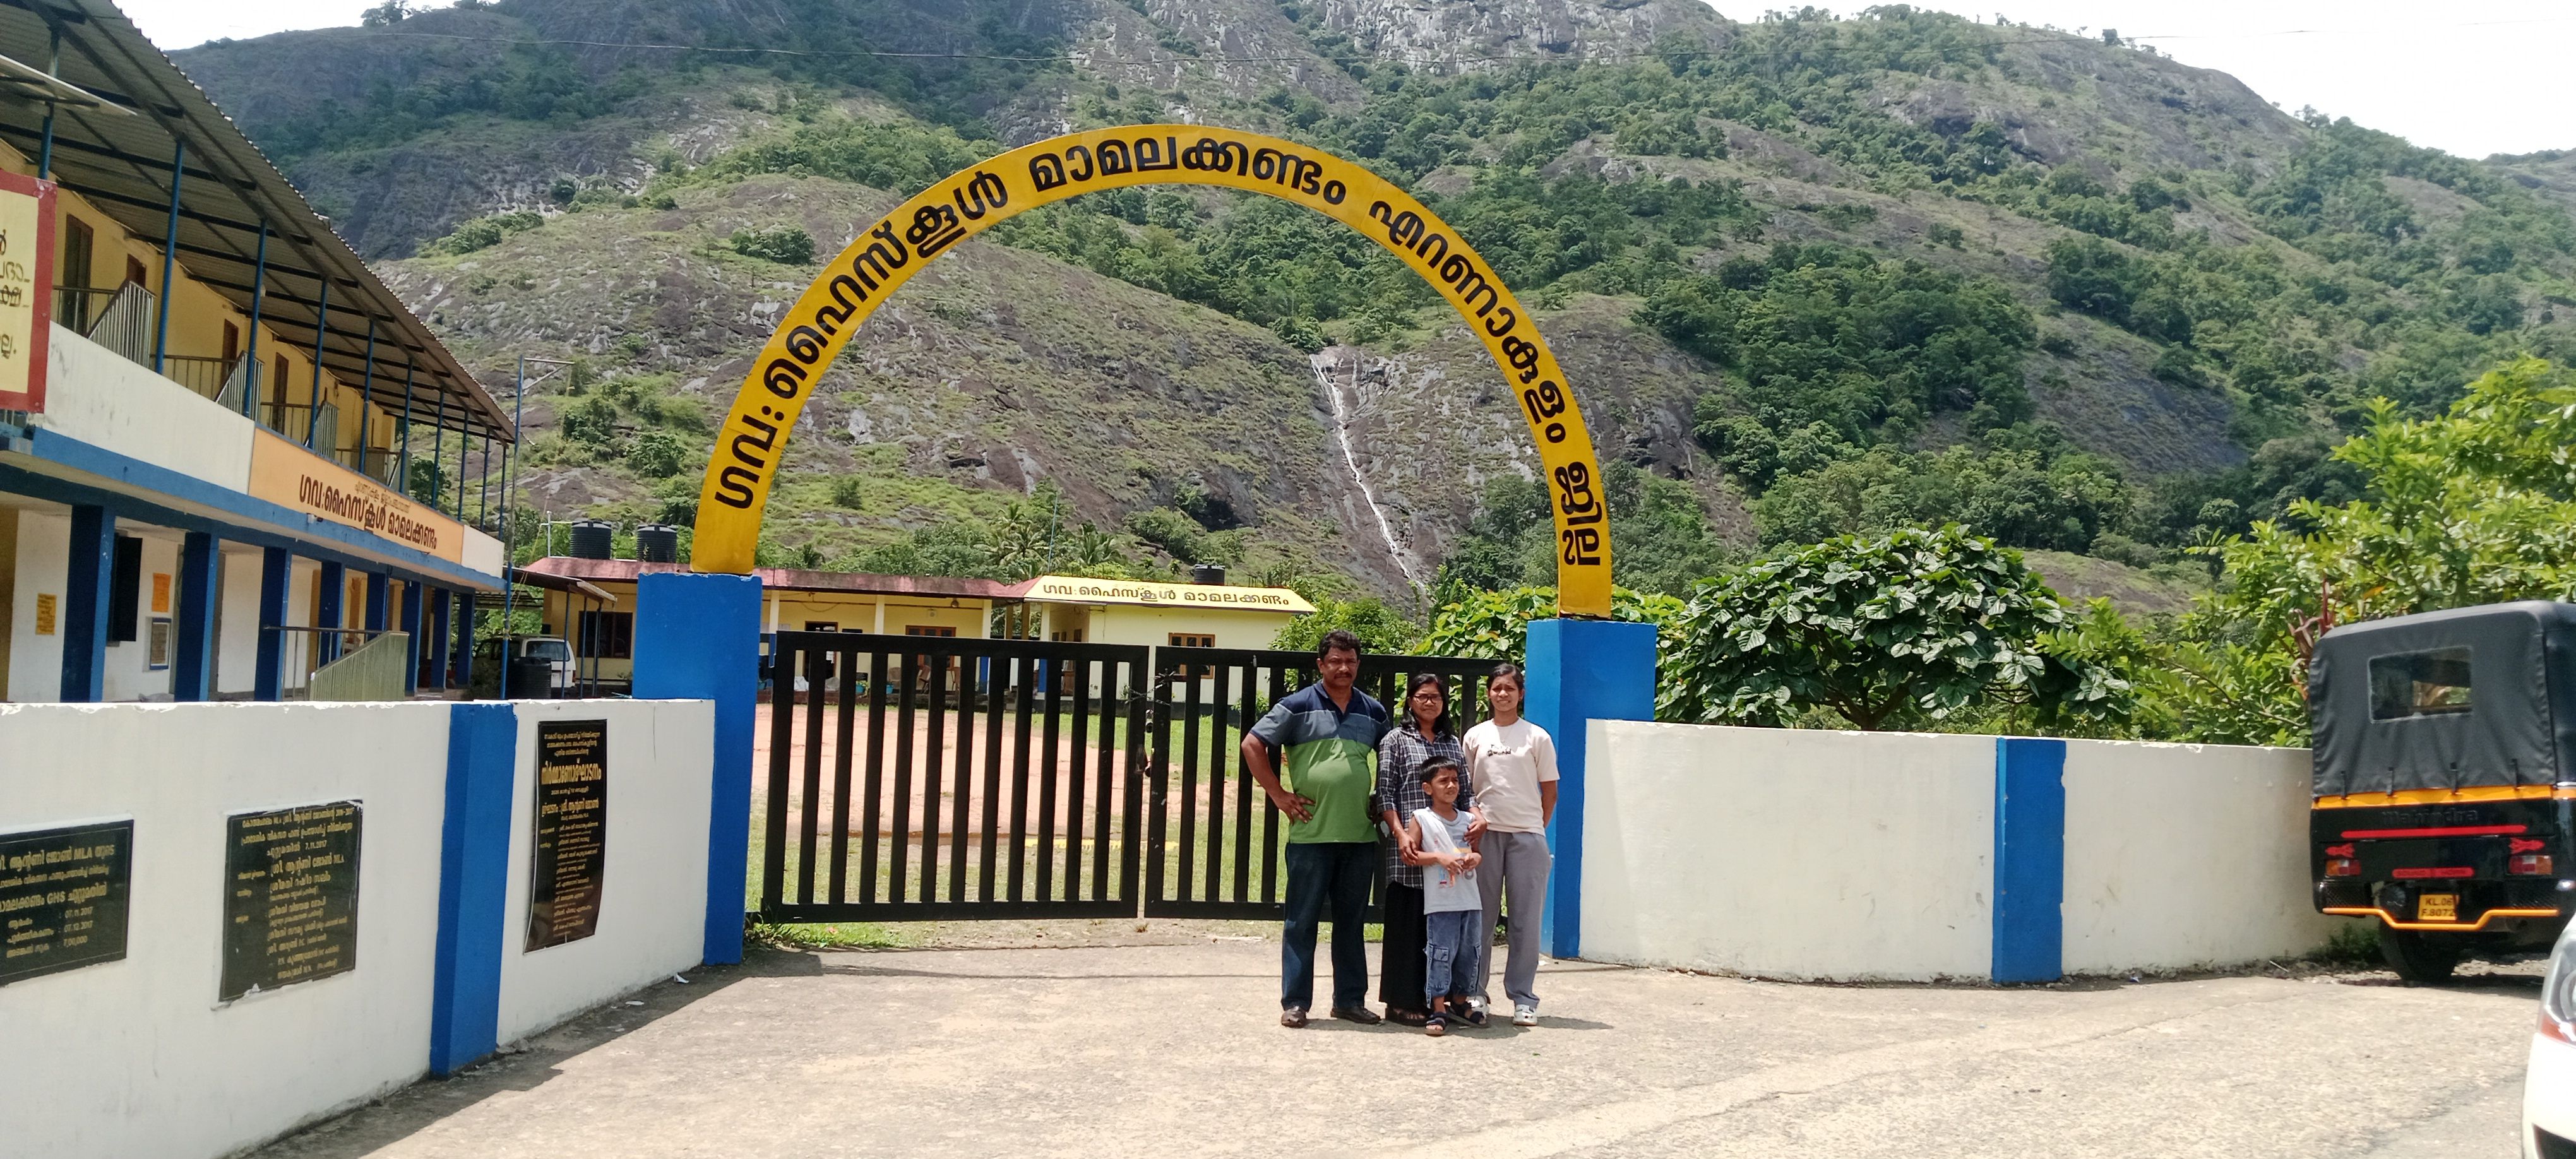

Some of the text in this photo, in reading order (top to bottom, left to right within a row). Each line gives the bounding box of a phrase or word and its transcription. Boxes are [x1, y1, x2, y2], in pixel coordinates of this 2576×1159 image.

[1028, 136, 1347, 205] മാമലക്കണ്ടം
[1369, 200, 1566, 444] എറണാകുളം
[1554, 461, 1602, 566] ജില്ല
[388, 511, 438, 550] മാമലക്കണ്ടം
[1184, 591, 1289, 606] മാമലക്കണ്ടം
[74, 847, 93, 860] MLA
[47, 891, 66, 905] GHS
